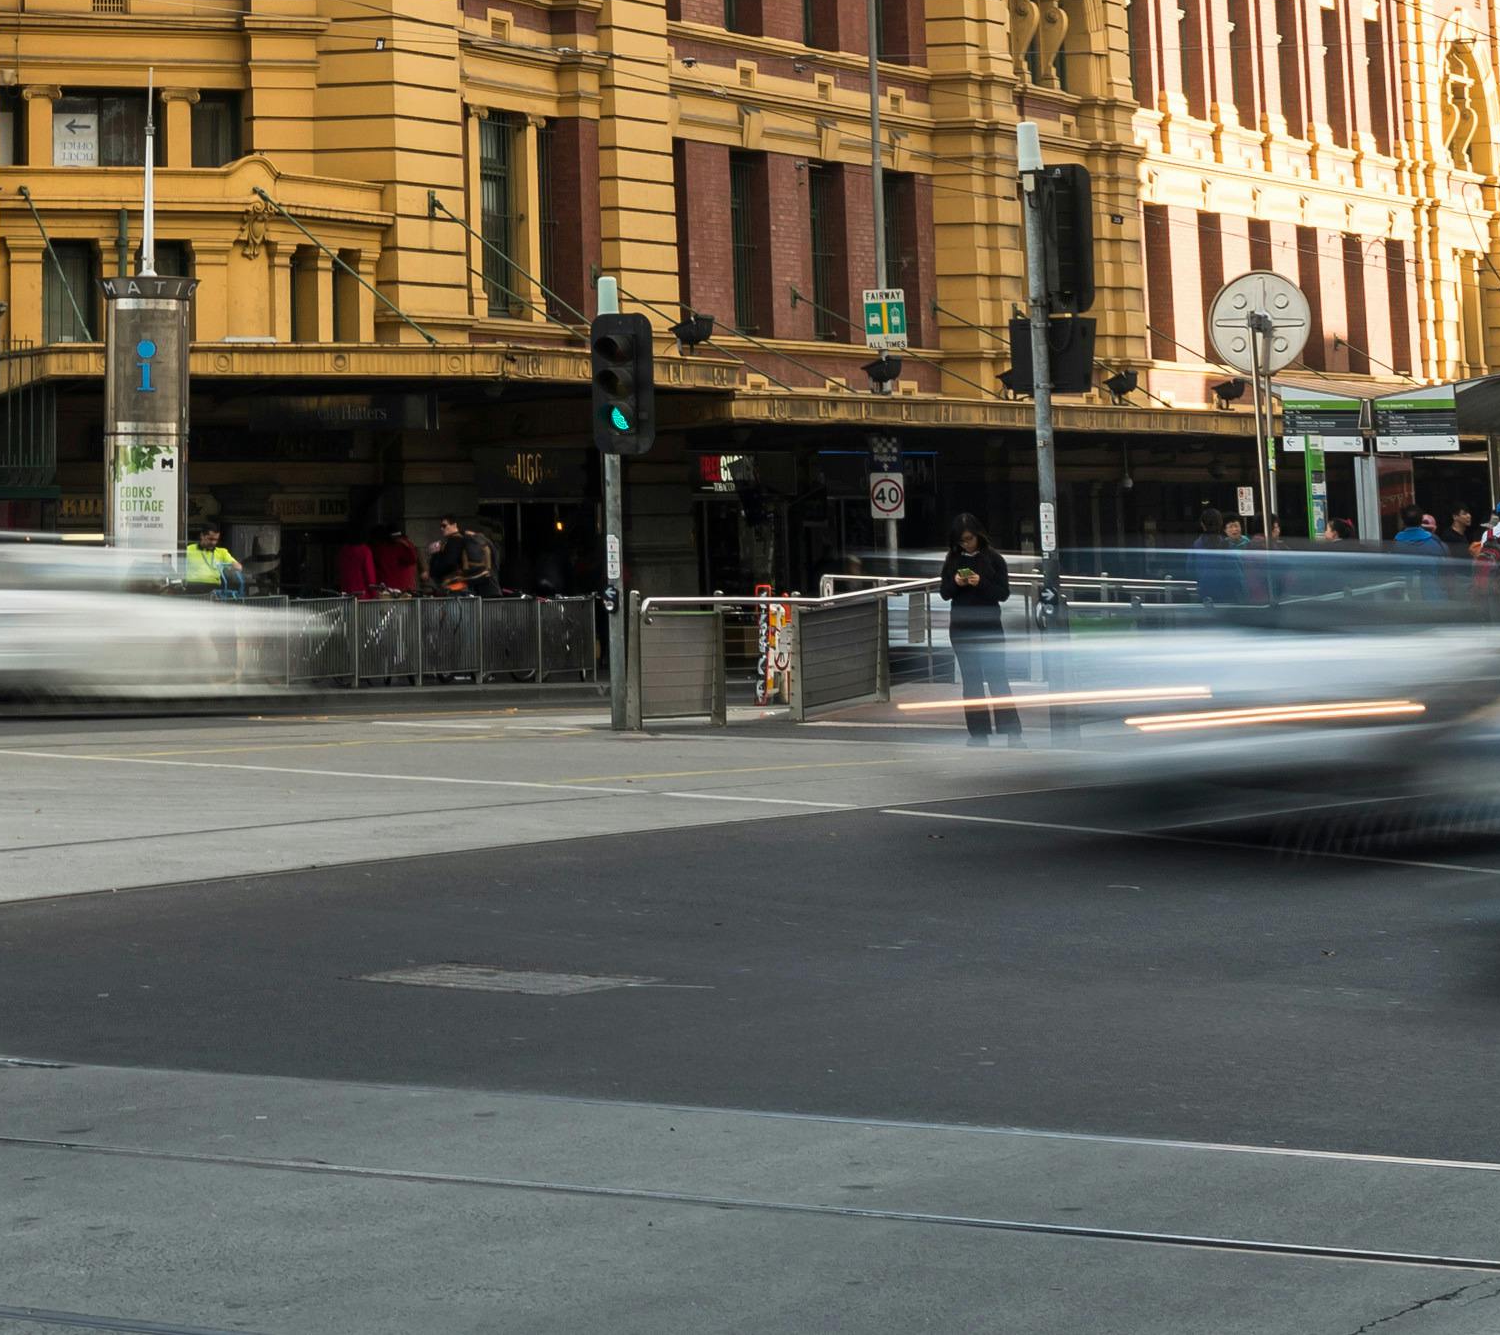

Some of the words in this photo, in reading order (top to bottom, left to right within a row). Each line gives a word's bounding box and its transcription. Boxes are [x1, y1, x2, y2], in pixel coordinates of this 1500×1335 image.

[865, 291, 901, 301] FAIRWAY
[869, 341, 882, 349] ALL
[885, 340, 906, 349] TIMES
[517, 453, 543, 486] UGG
[875, 487, 899, 504] 40
[120, 499, 165, 513] COTTAGE
